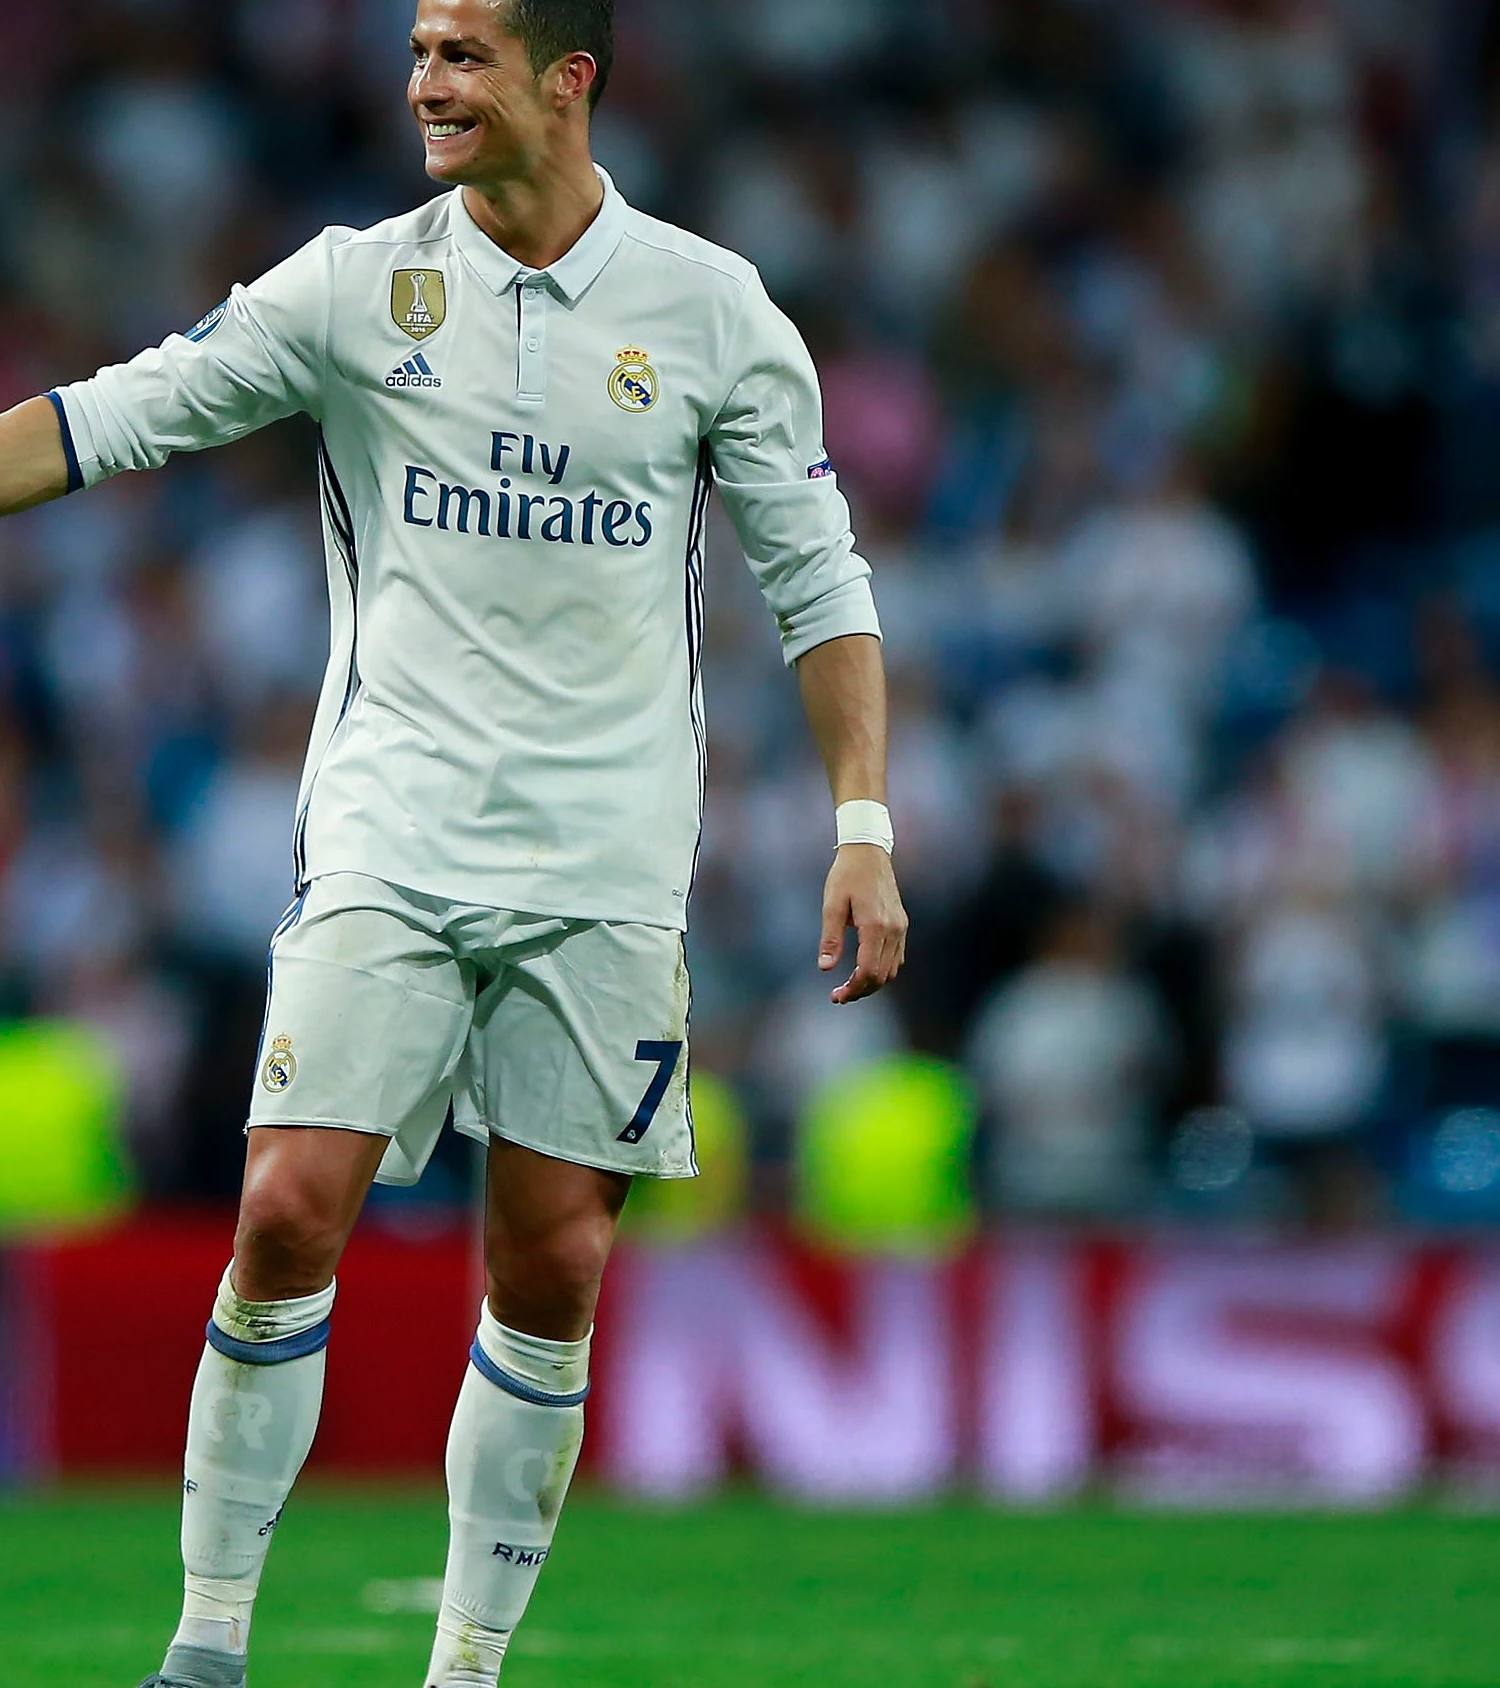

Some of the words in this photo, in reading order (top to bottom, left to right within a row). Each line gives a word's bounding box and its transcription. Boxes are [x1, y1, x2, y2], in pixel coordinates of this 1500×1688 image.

[406, 313, 432, 323] FIFA
[385, 374, 443, 388] adidas
[490, 431, 571, 485] Fly
[403, 464, 653, 547] Emirates
[615, 1039, 683, 1145] 7
